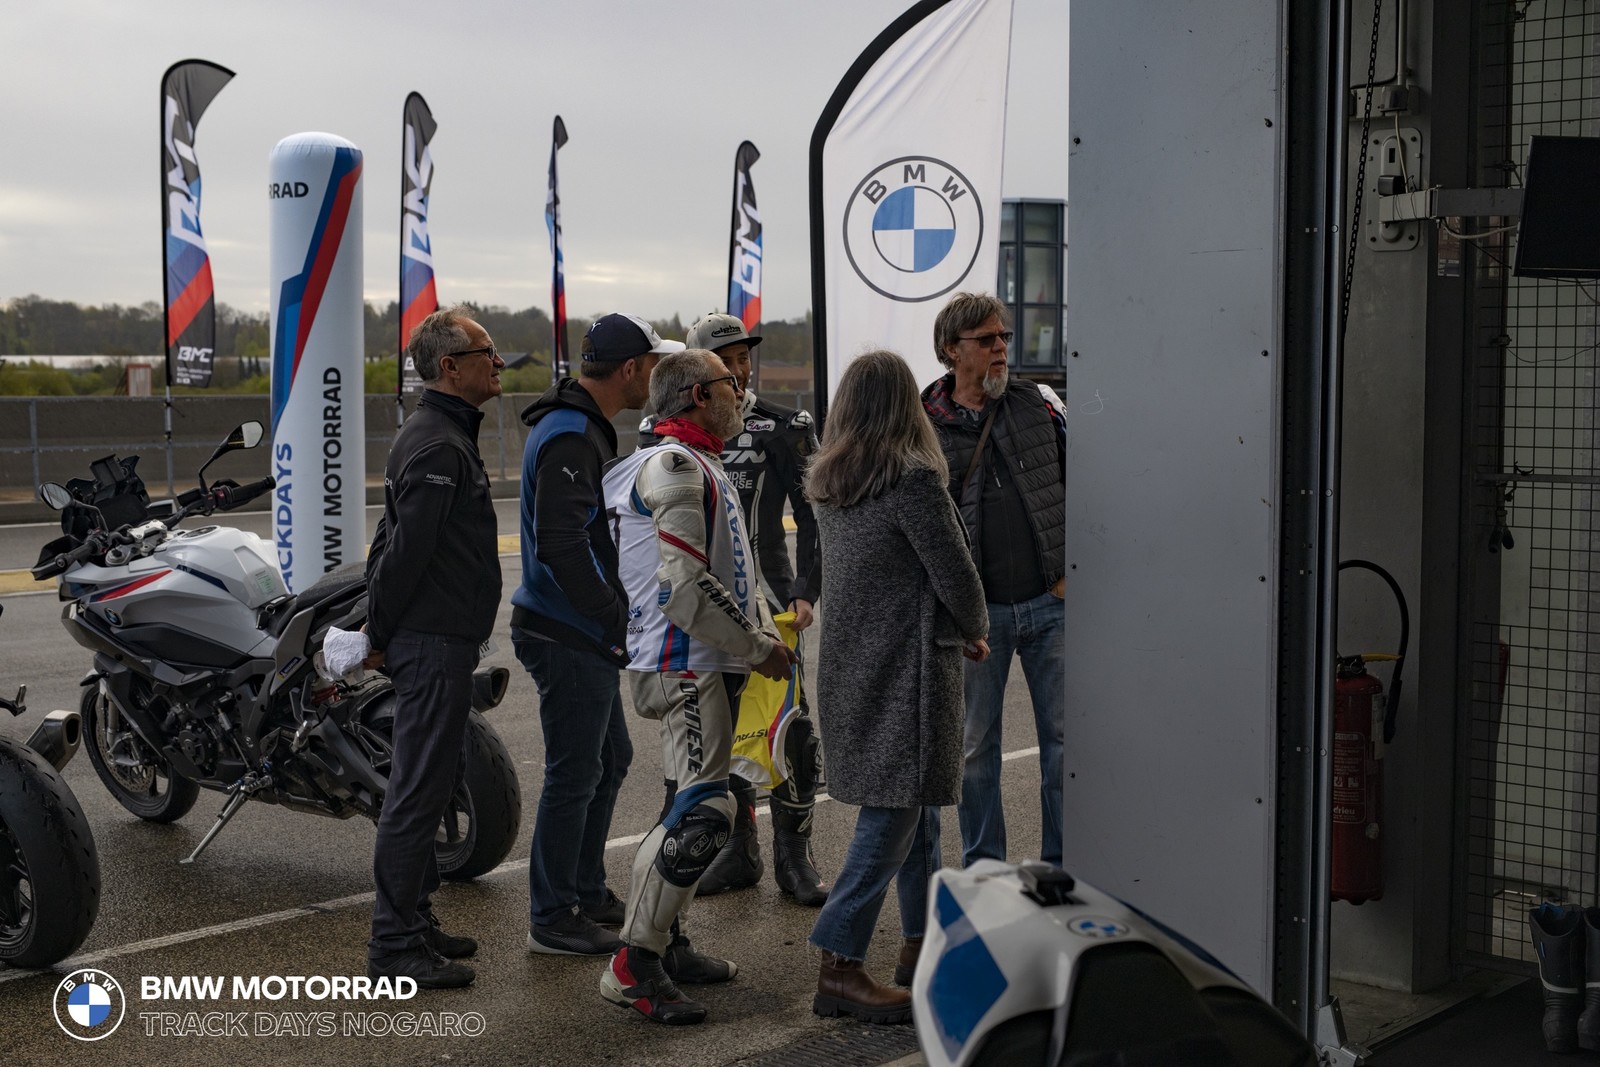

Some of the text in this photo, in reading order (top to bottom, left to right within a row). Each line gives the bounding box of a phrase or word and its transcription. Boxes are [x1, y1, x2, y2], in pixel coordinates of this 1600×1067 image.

[862, 164, 967, 205] BMW
[323, 367, 342, 573] MW MOTORRAD
[276, 443, 292, 594] ACKDAYS
[719, 479, 748, 618] ACKDAYS
[697, 579, 753, 631] DAINESE
[679, 682, 704, 776] DAINESE
[1333, 805, 1356, 814] drieu
